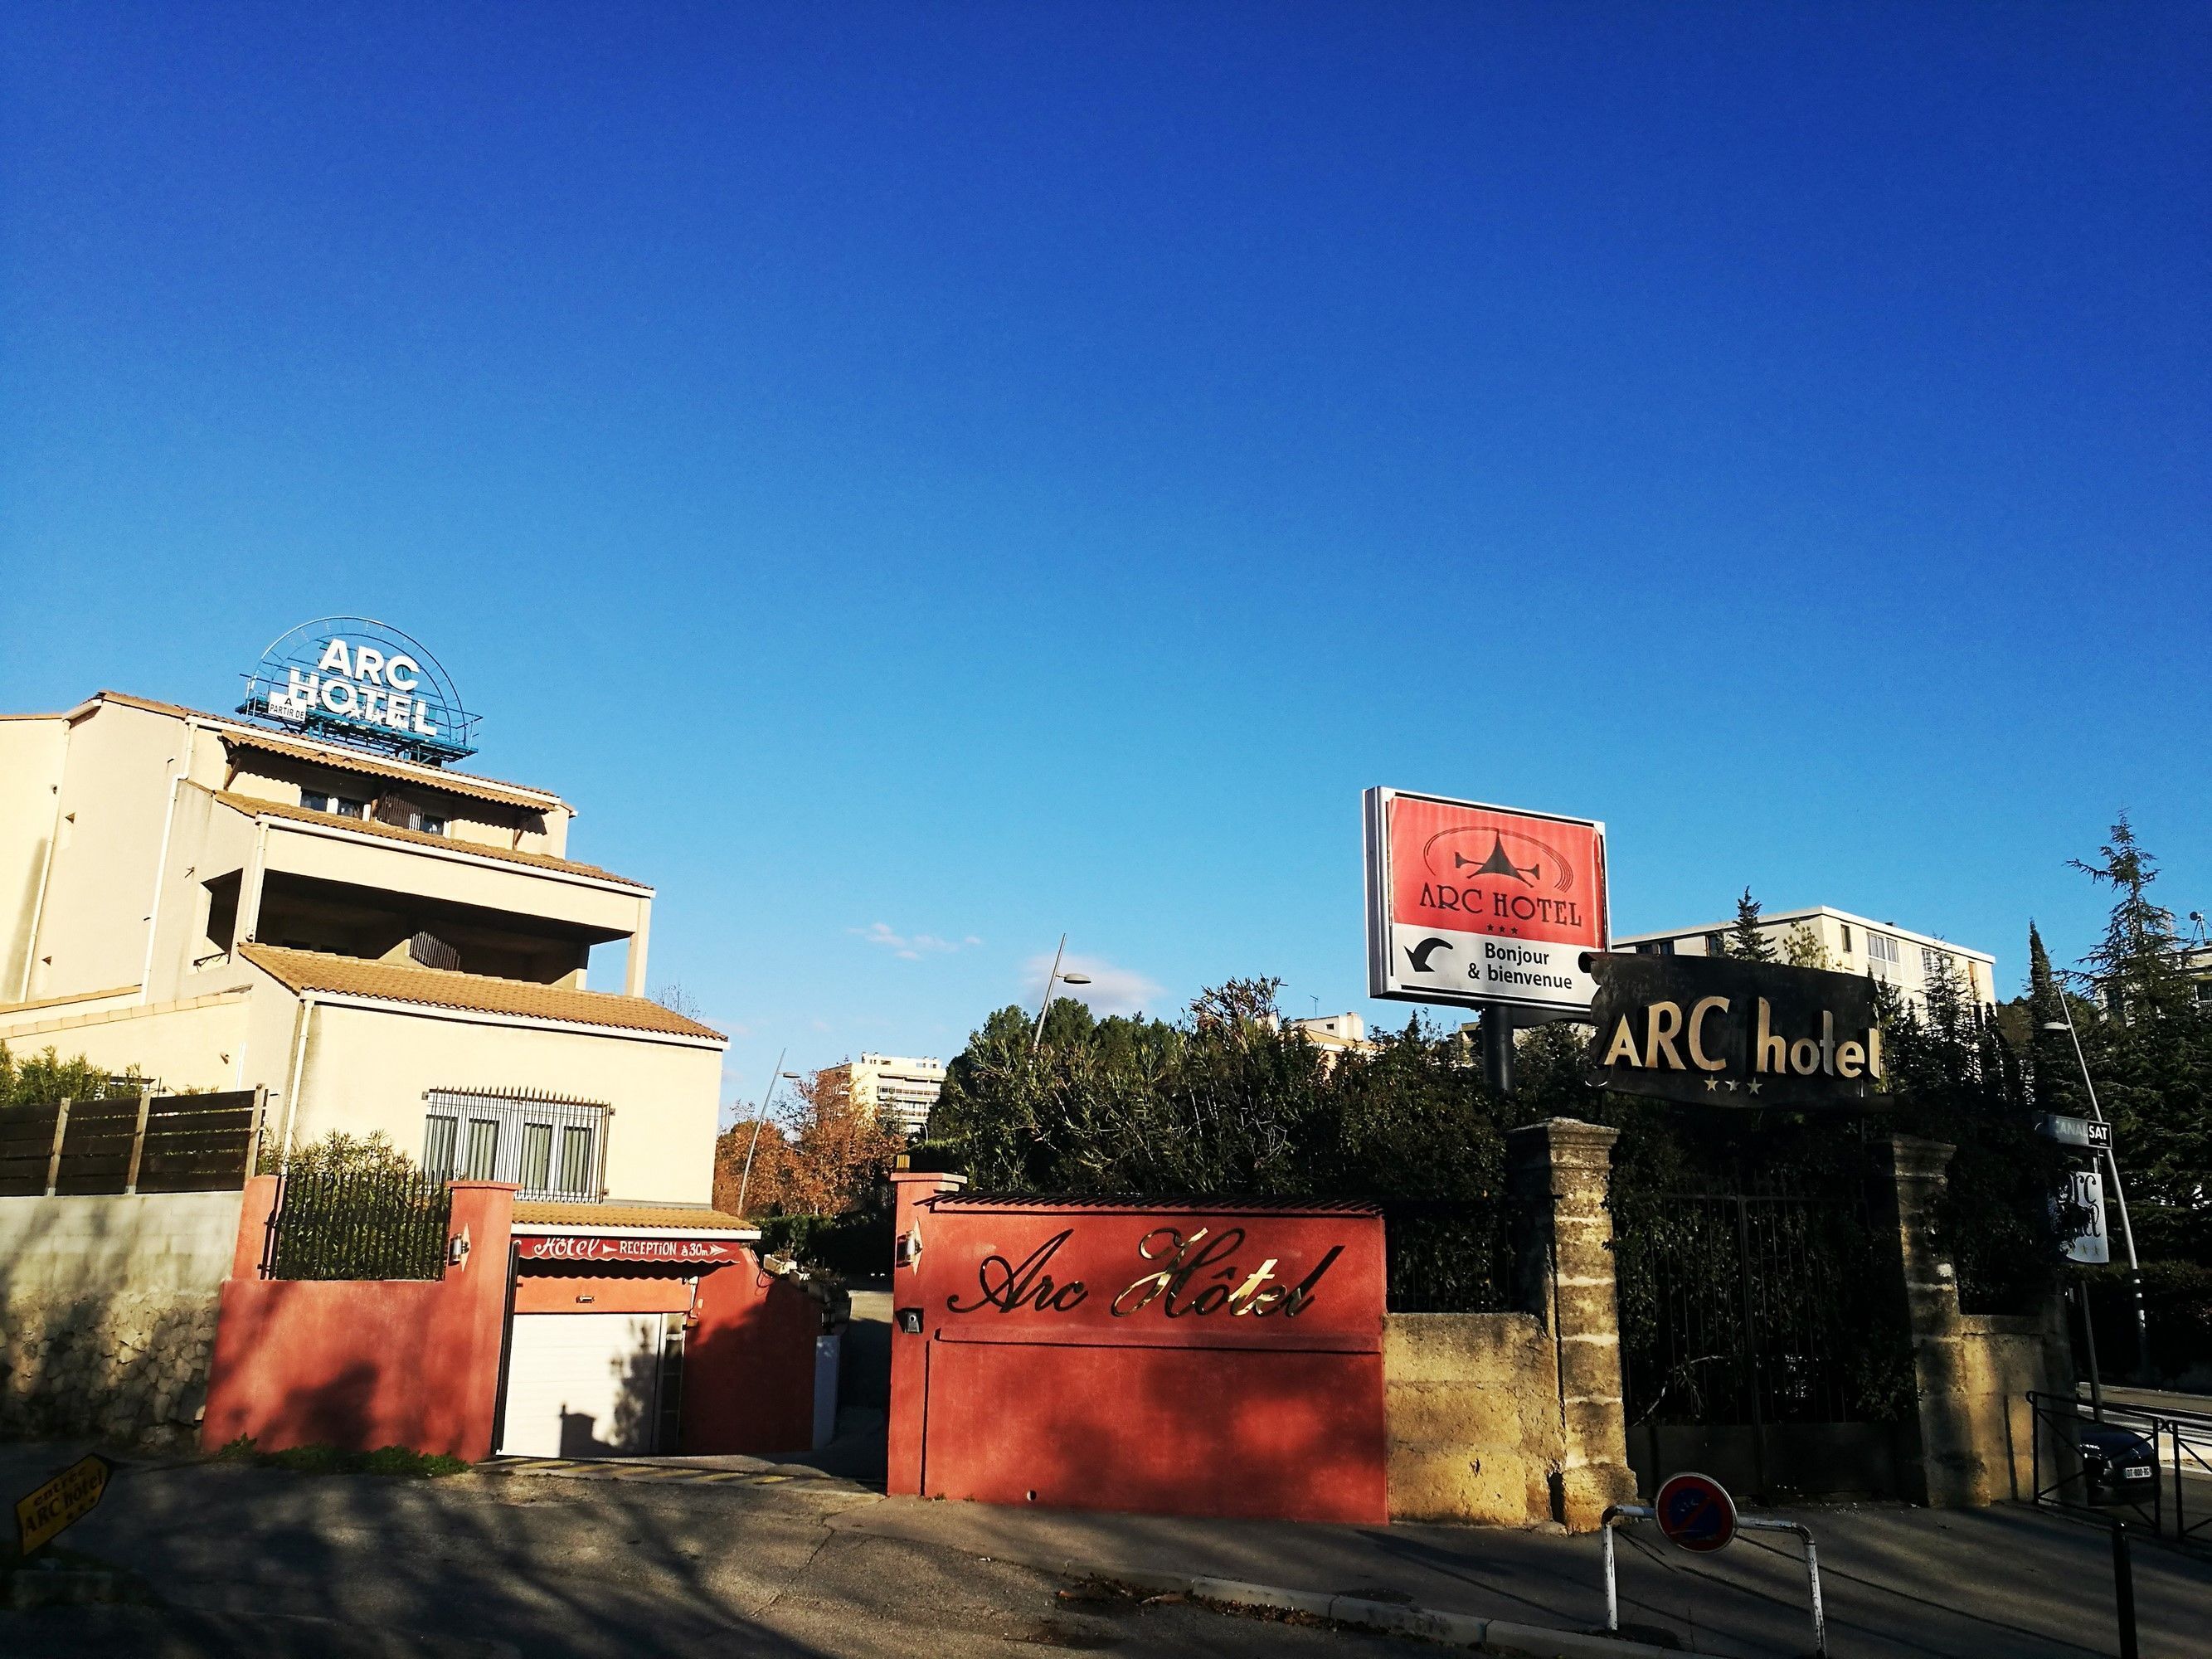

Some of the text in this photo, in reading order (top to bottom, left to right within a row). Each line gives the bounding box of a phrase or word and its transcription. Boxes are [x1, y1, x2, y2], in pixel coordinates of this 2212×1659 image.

[318, 639, 421, 691] ARC
[270, 704, 304, 720] PARTIR DE
[284, 698, 292, 706] A
[288, 666, 438, 737] HOTEL
[1420, 882, 1582, 927] ARC HOTEL
[1485, 942, 1549, 966] Bonjour
[1468, 962, 1573, 990] & bienvenue
[1603, 995, 1881, 1079] ARC hotel
[533, 1237, 600, 1258] Hôtel
[947, 1227, 1345, 1319] Arc Hôtel
[26, 1496, 61, 1537] ARC
